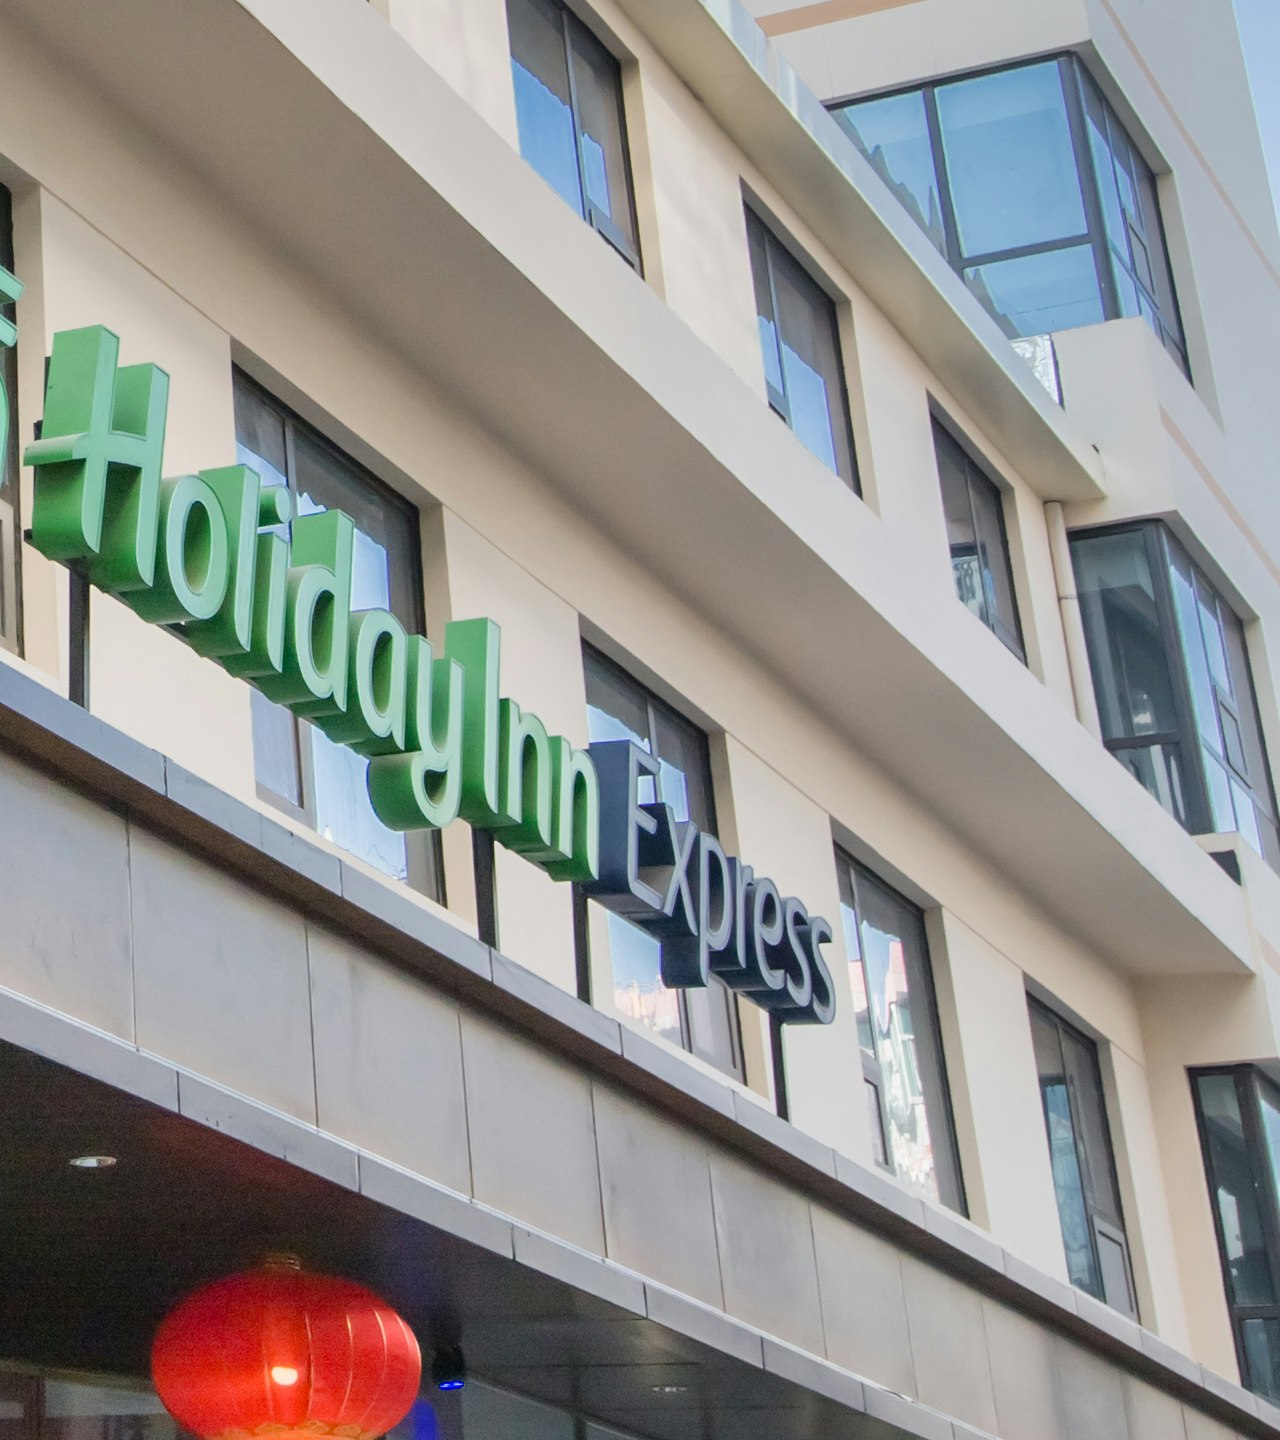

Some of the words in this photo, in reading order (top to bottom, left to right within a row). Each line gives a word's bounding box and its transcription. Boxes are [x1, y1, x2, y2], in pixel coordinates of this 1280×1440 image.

[23, 324, 464, 831] Holiday
[446, 617, 600, 883] Inn
[590, 739, 835, 1025] Express
